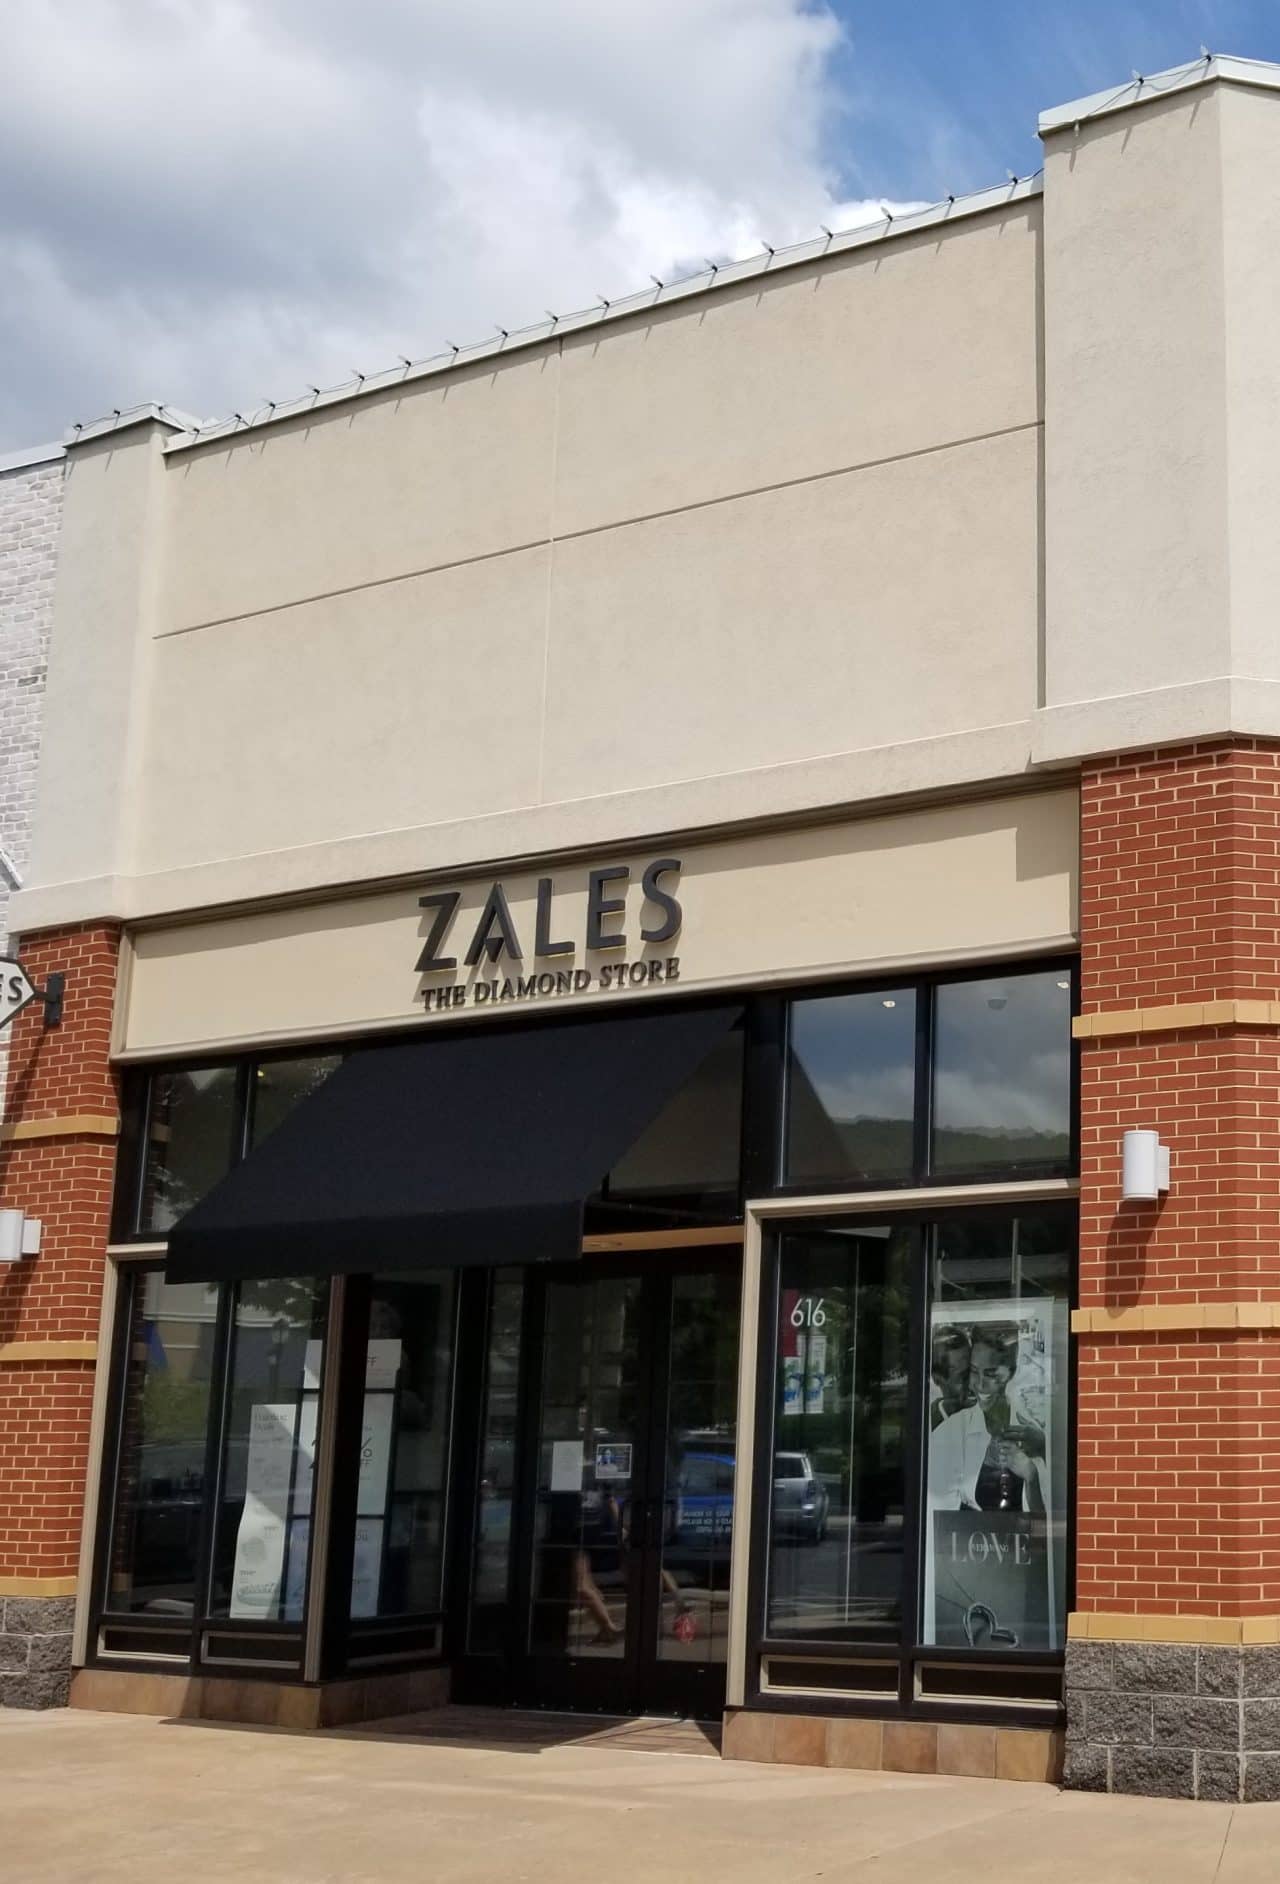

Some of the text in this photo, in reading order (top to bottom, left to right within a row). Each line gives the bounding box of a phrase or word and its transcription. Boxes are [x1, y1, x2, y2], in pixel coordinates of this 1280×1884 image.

[414, 859, 683, 972] ZALES
[421, 957, 681, 1010] THE DIAMOND STORE
[791, 1298, 826, 1327] 616
[951, 1531, 1032, 1565] LOVE
